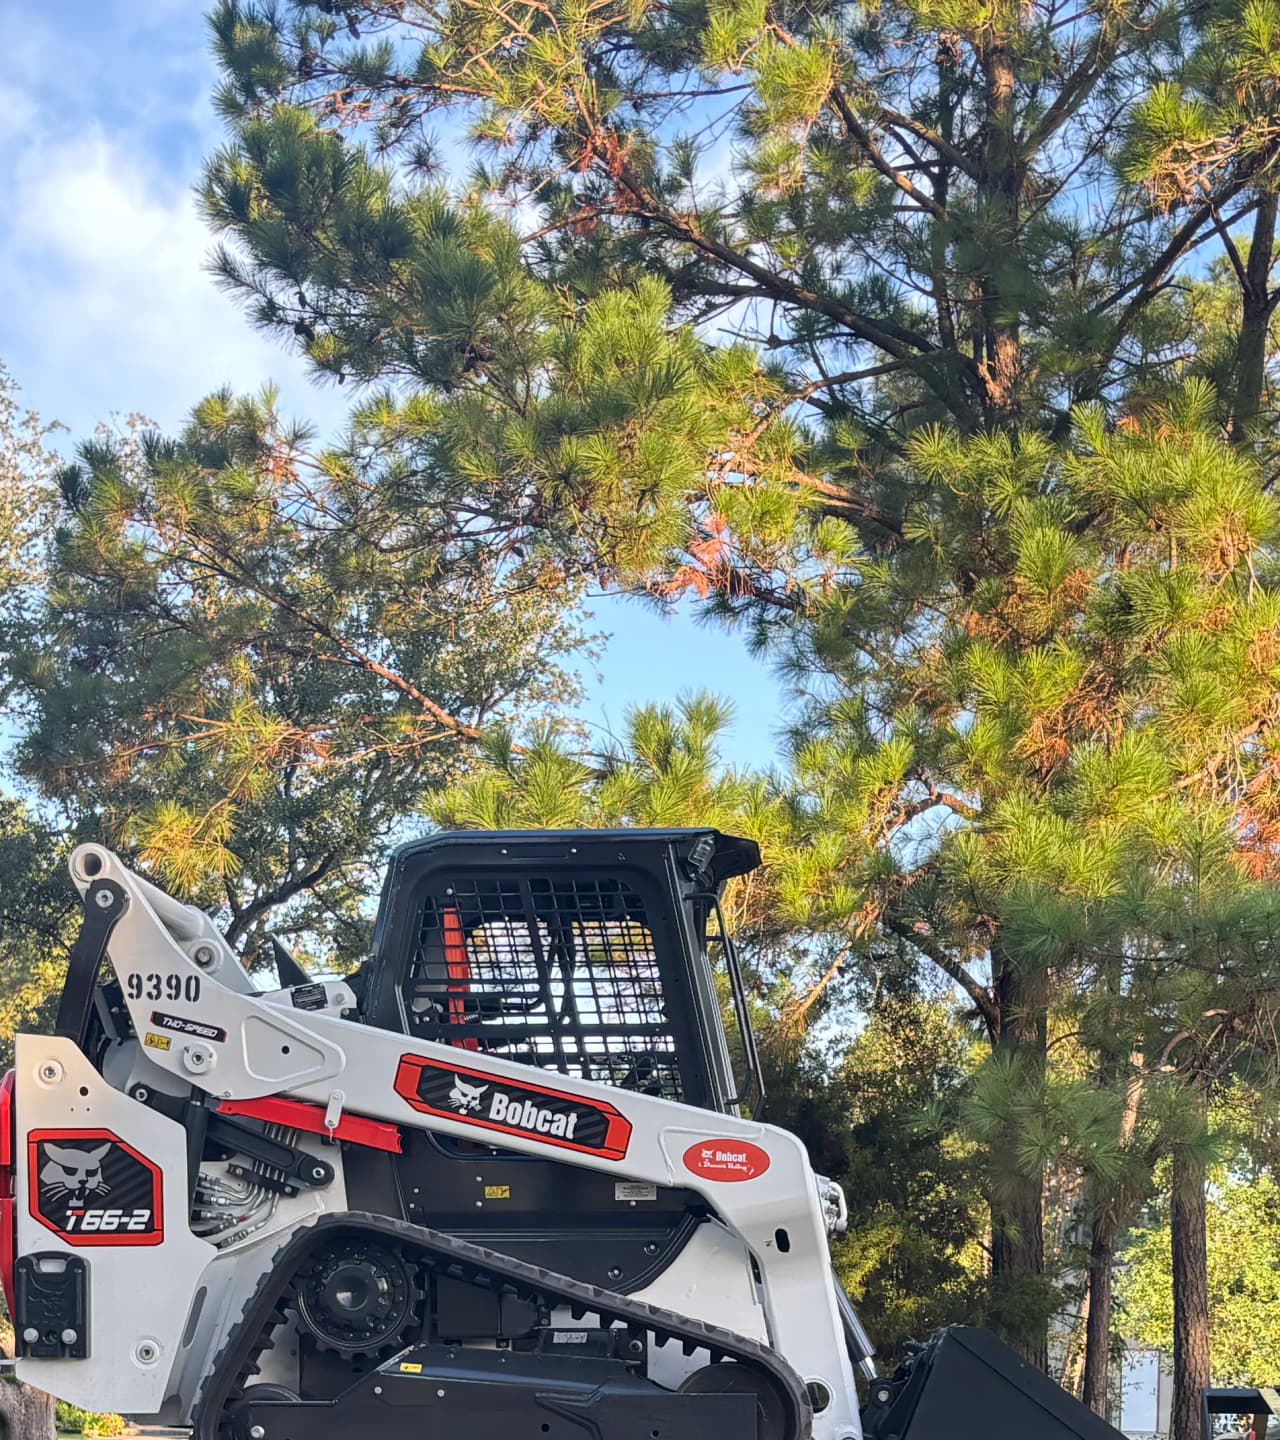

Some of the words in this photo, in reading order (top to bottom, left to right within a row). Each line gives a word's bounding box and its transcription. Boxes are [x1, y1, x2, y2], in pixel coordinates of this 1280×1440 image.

[127, 972, 200, 1003] 9390
[162, 1016, 218, 1037] TWO-SPEED
[488, 1091, 578, 1139] Bobcat
[715, 1151, 747, 1162] Bobcat
[65, 1209, 151, 1231] T66-2
